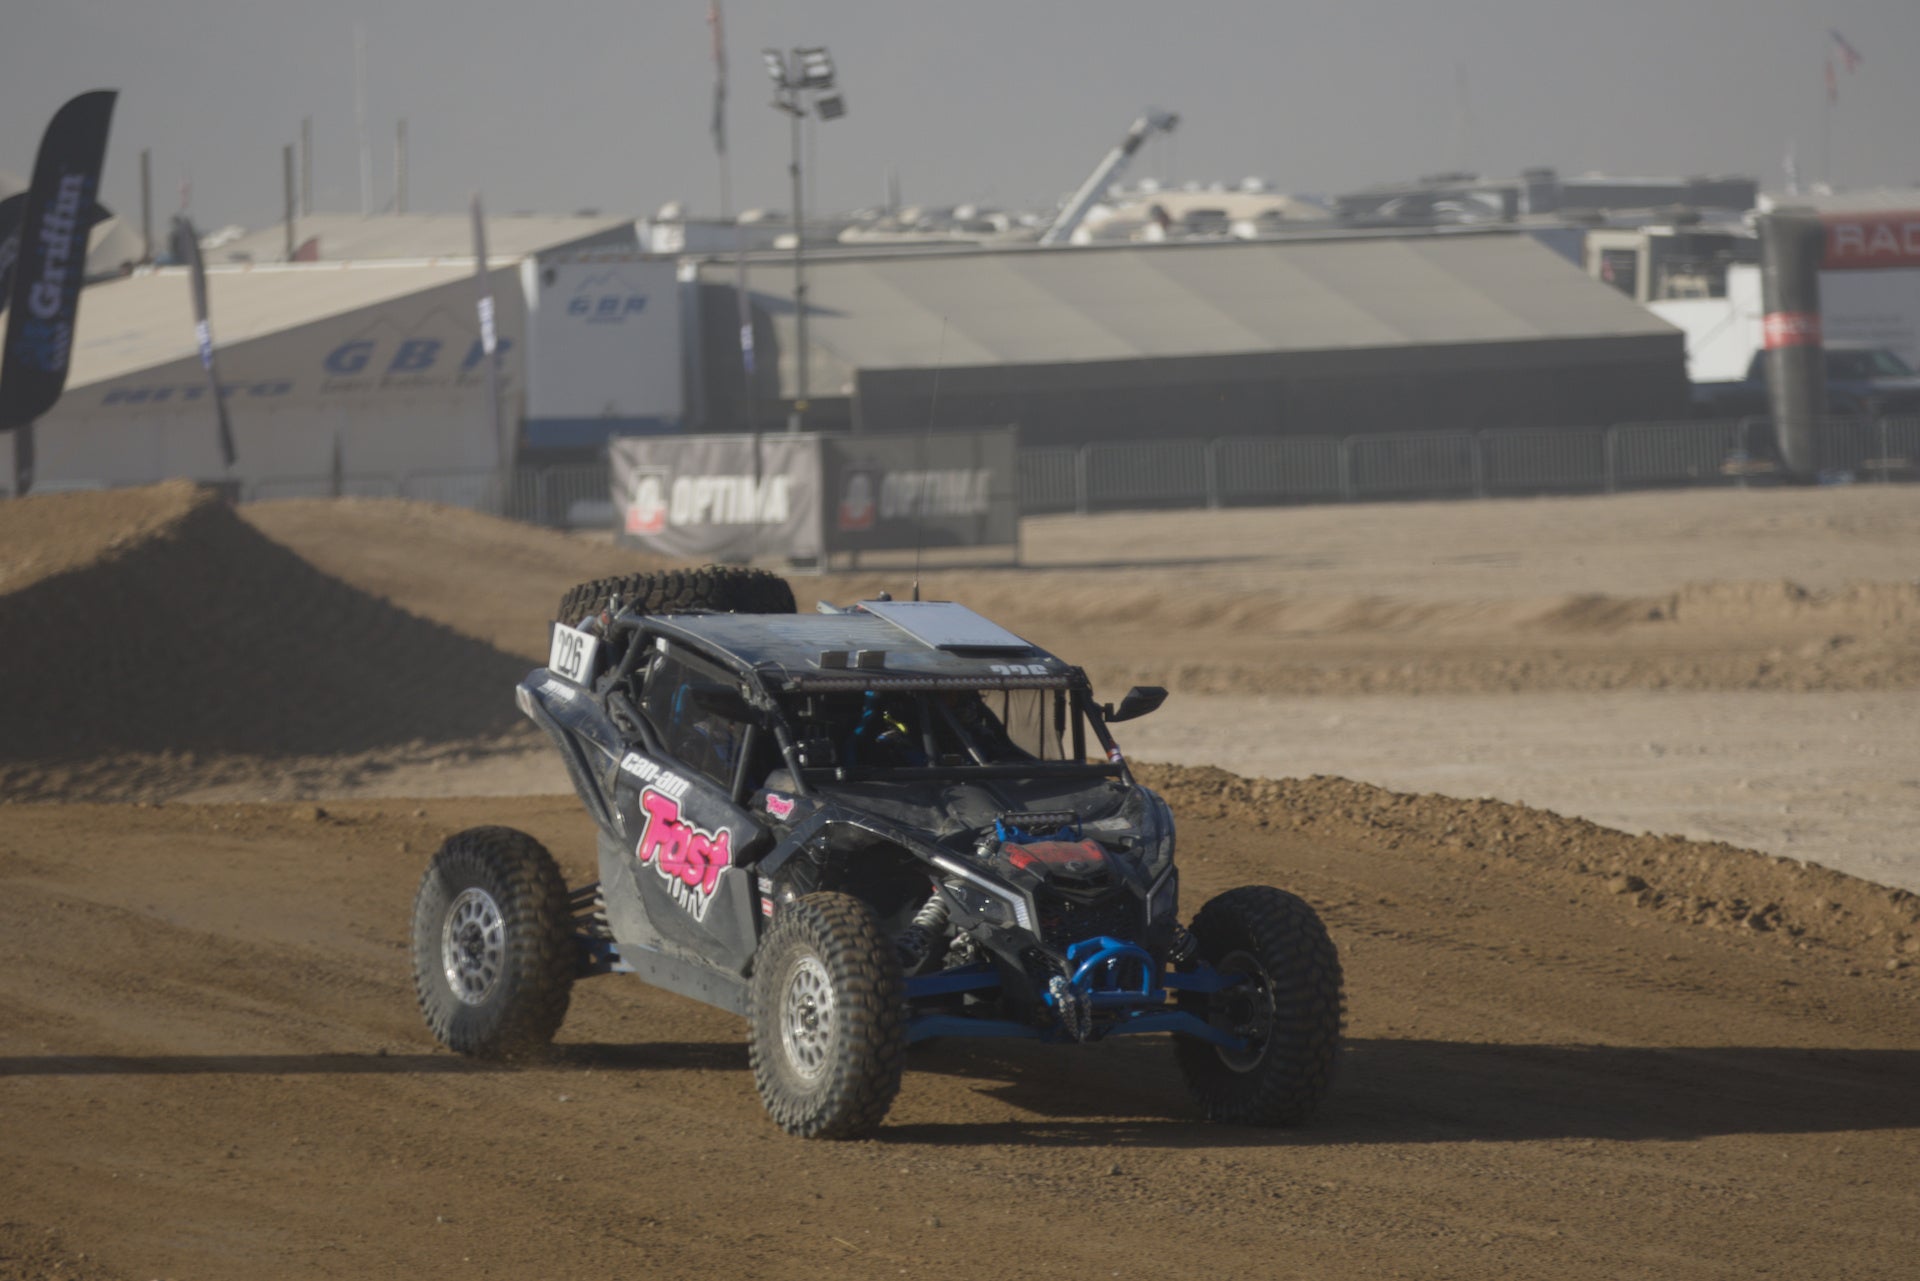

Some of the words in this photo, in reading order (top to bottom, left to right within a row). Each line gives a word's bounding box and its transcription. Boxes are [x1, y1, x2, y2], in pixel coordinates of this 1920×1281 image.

[29, 172, 86, 319] Griffin
[670, 473, 791, 526] OPTIMA
[557, 629, 584, 679] 226
[620, 752, 691, 797] can-am
